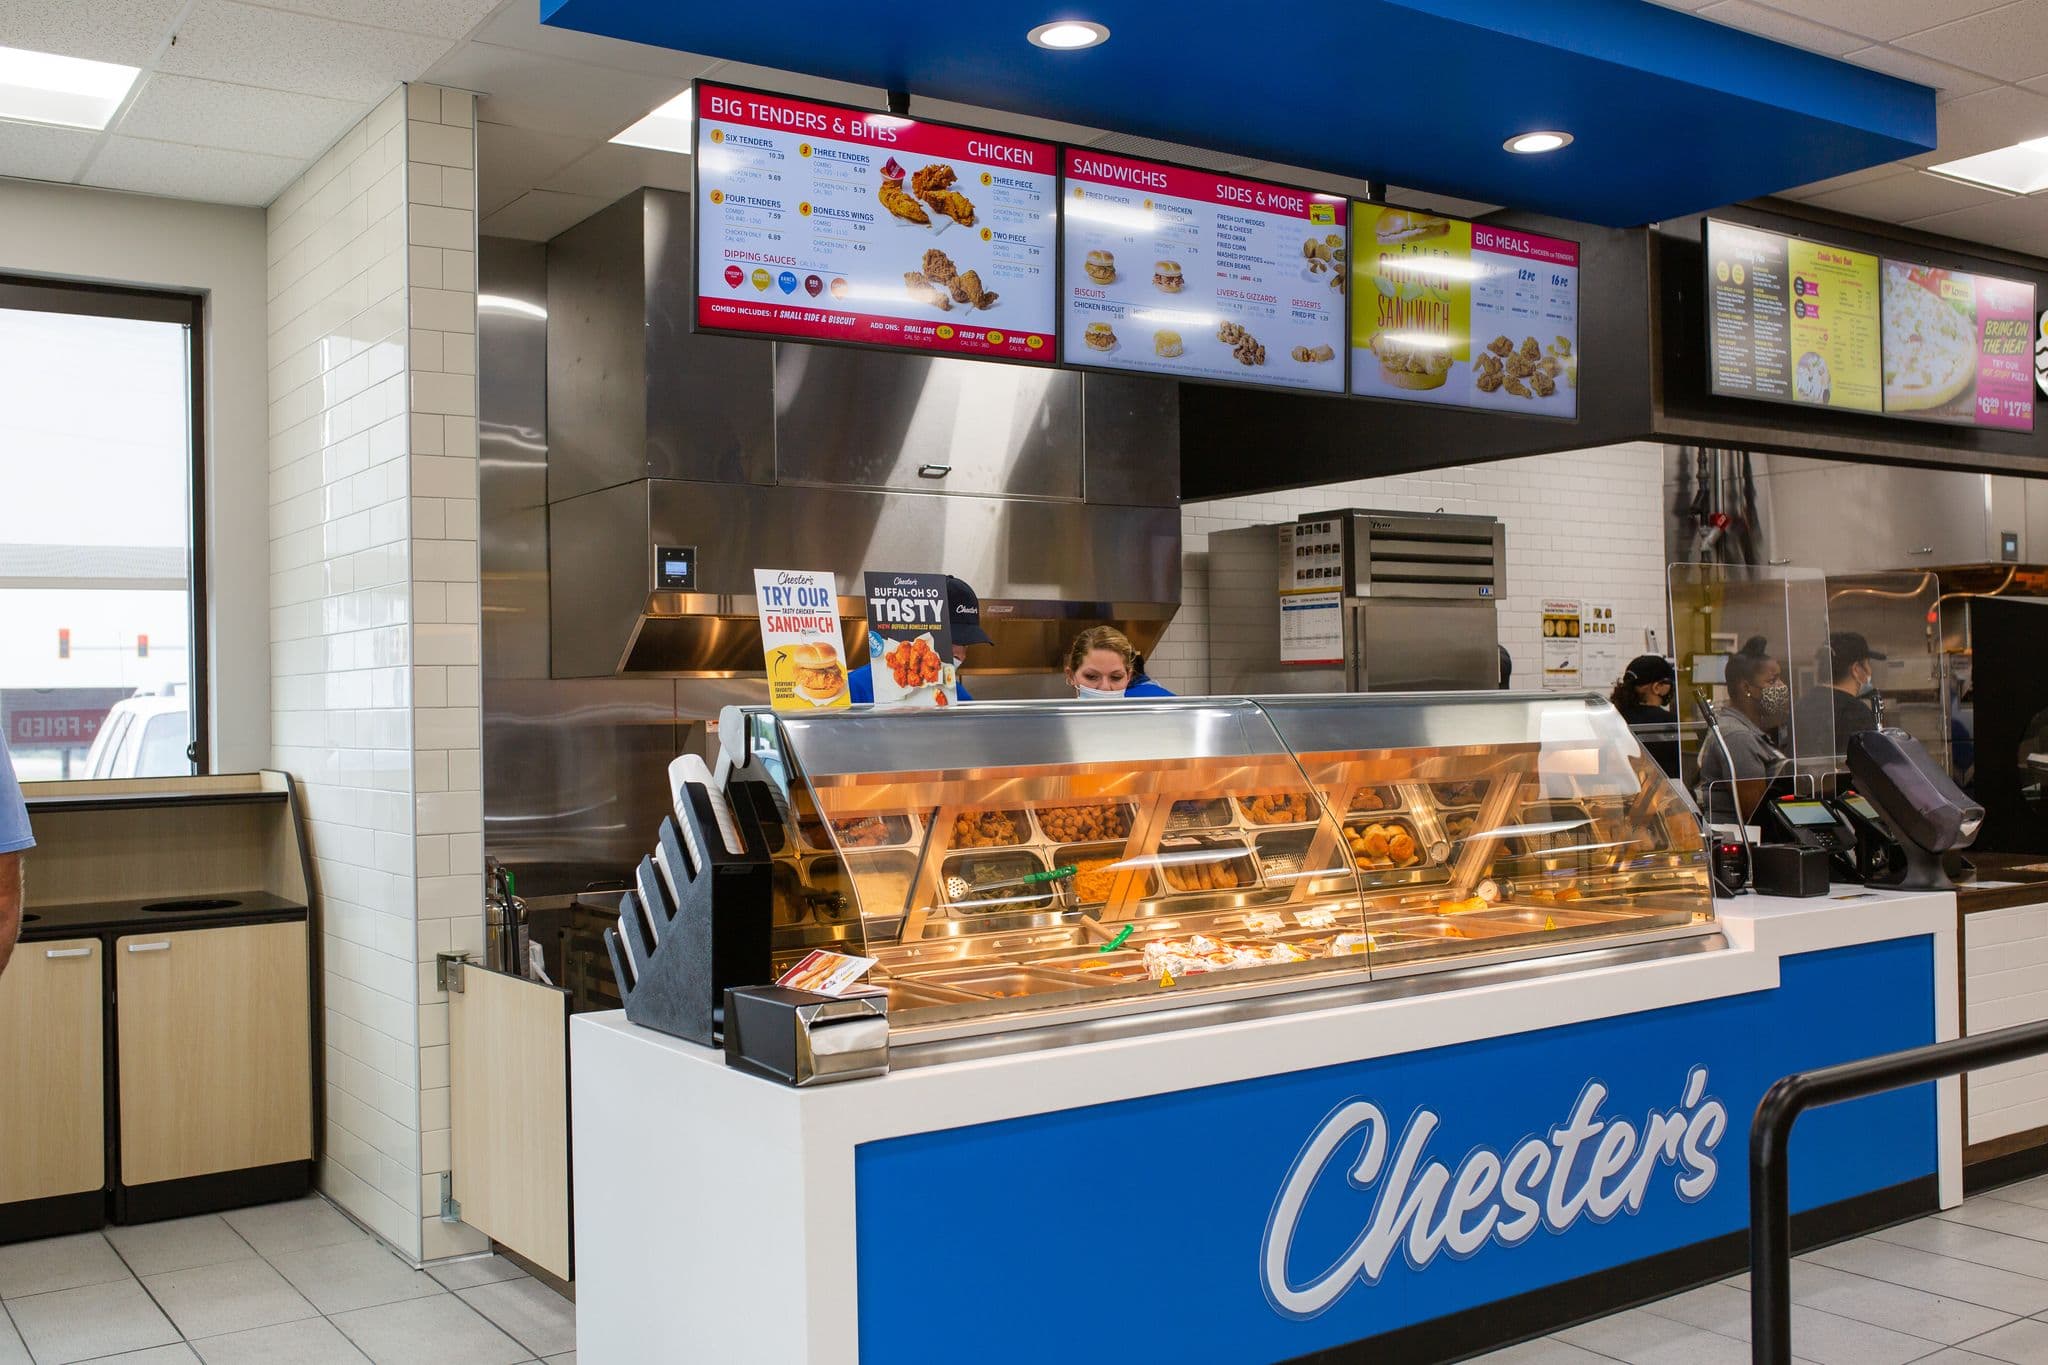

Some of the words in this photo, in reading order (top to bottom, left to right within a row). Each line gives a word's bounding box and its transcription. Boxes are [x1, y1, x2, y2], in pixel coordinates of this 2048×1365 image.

[711, 96, 743, 117] BIG
[748, 102, 827, 131] TENDERS
[832, 117, 846, 134] &
[851, 121, 897, 143] BITES
[725, 133, 738, 143] SIX
[739, 135, 773, 148] TENDERS
[813, 147, 837, 159] THREE
[838, 150, 870, 164] TENDERS
[967, 140, 1034, 166] CHICKEN
[1073, 158, 1168, 188] SANDWICHES
[993, 176, 1014, 187] THREE
[1015, 179, 1033, 190] PIECE
[725, 193, 746, 203] FOUR
[747, 196, 781, 208] TENDERS
[1085, 191, 1103, 200] FRIED
[1104, 194, 1130, 205] CHICKEN
[1216, 184, 1252, 203] SIDES
[1255, 191, 1265, 206] &
[1268, 193, 1304, 213] MORE
[813, 206, 850, 218] BONELESS
[851, 211, 874, 222] WINGS
[1154, 202, 1167, 211] BBQ
[1167, 205, 1193, 215] CHICKEN
[993, 231, 1007, 241] TWO
[1008, 234, 1027, 243] PIECE
[1216, 232, 1232, 241] FRIED
[1475, 231, 1494, 247] BIG
[1496, 235, 1530, 253] MEALS
[1216, 241, 1232, 249] FRIED
[1232, 244, 1247, 252] CORN
[724, 249, 761, 261] DIPPING
[763, 251, 796, 266] SAUCES
[1216, 260, 1234, 269] GREEN
[1234, 263, 1251, 271] BEANS
[1074, 287, 1106, 299] BISCUITS
[1216, 287, 1239, 298] LIVERS
[1246, 292, 1277, 304] GIZZARDS
[1073, 301, 1101, 311] CHICKEN
[1101, 305, 1125, 313] BISCUIT
[1291, 298, 1321, 310] DESSERTS
[711, 304, 736, 314] COMBO
[737, 307, 772, 318] INCLUDES:
[779, 310, 802, 321] SMALL
[803, 313, 820, 322] SIDE
[828, 315, 856, 326] BISCUIT
[1291, 310, 1307, 319] FRIED
[870, 322, 884, 330] ADD
[904, 325, 921, 334] SMALL
[922, 327, 936, 335] SIDE
[959, 331, 975, 340] FRIED
[1008, 336, 1025, 345] DRINK
[1985, 320, 2014, 337] BRING
[2014, 321, 2029, 337] ON
[1983, 338, 2001, 354] THE
[2002, 339, 2027, 355] HEAT
[777, 571, 814, 586] Chester's
[893, 576, 918, 586] Chester's
[762, 585, 791, 607] TRY
[798, 586, 829, 608] OUR
[874, 587, 924, 598] BUFFAL-OH
[926, 588, 939, 598] SO
[795, 608, 815, 616] CHICKEN
[870, 598, 944, 623] TASTY
[767, 616, 834, 634] SANDWICH
[1264, 1068, 1727, 1315] Chester's
